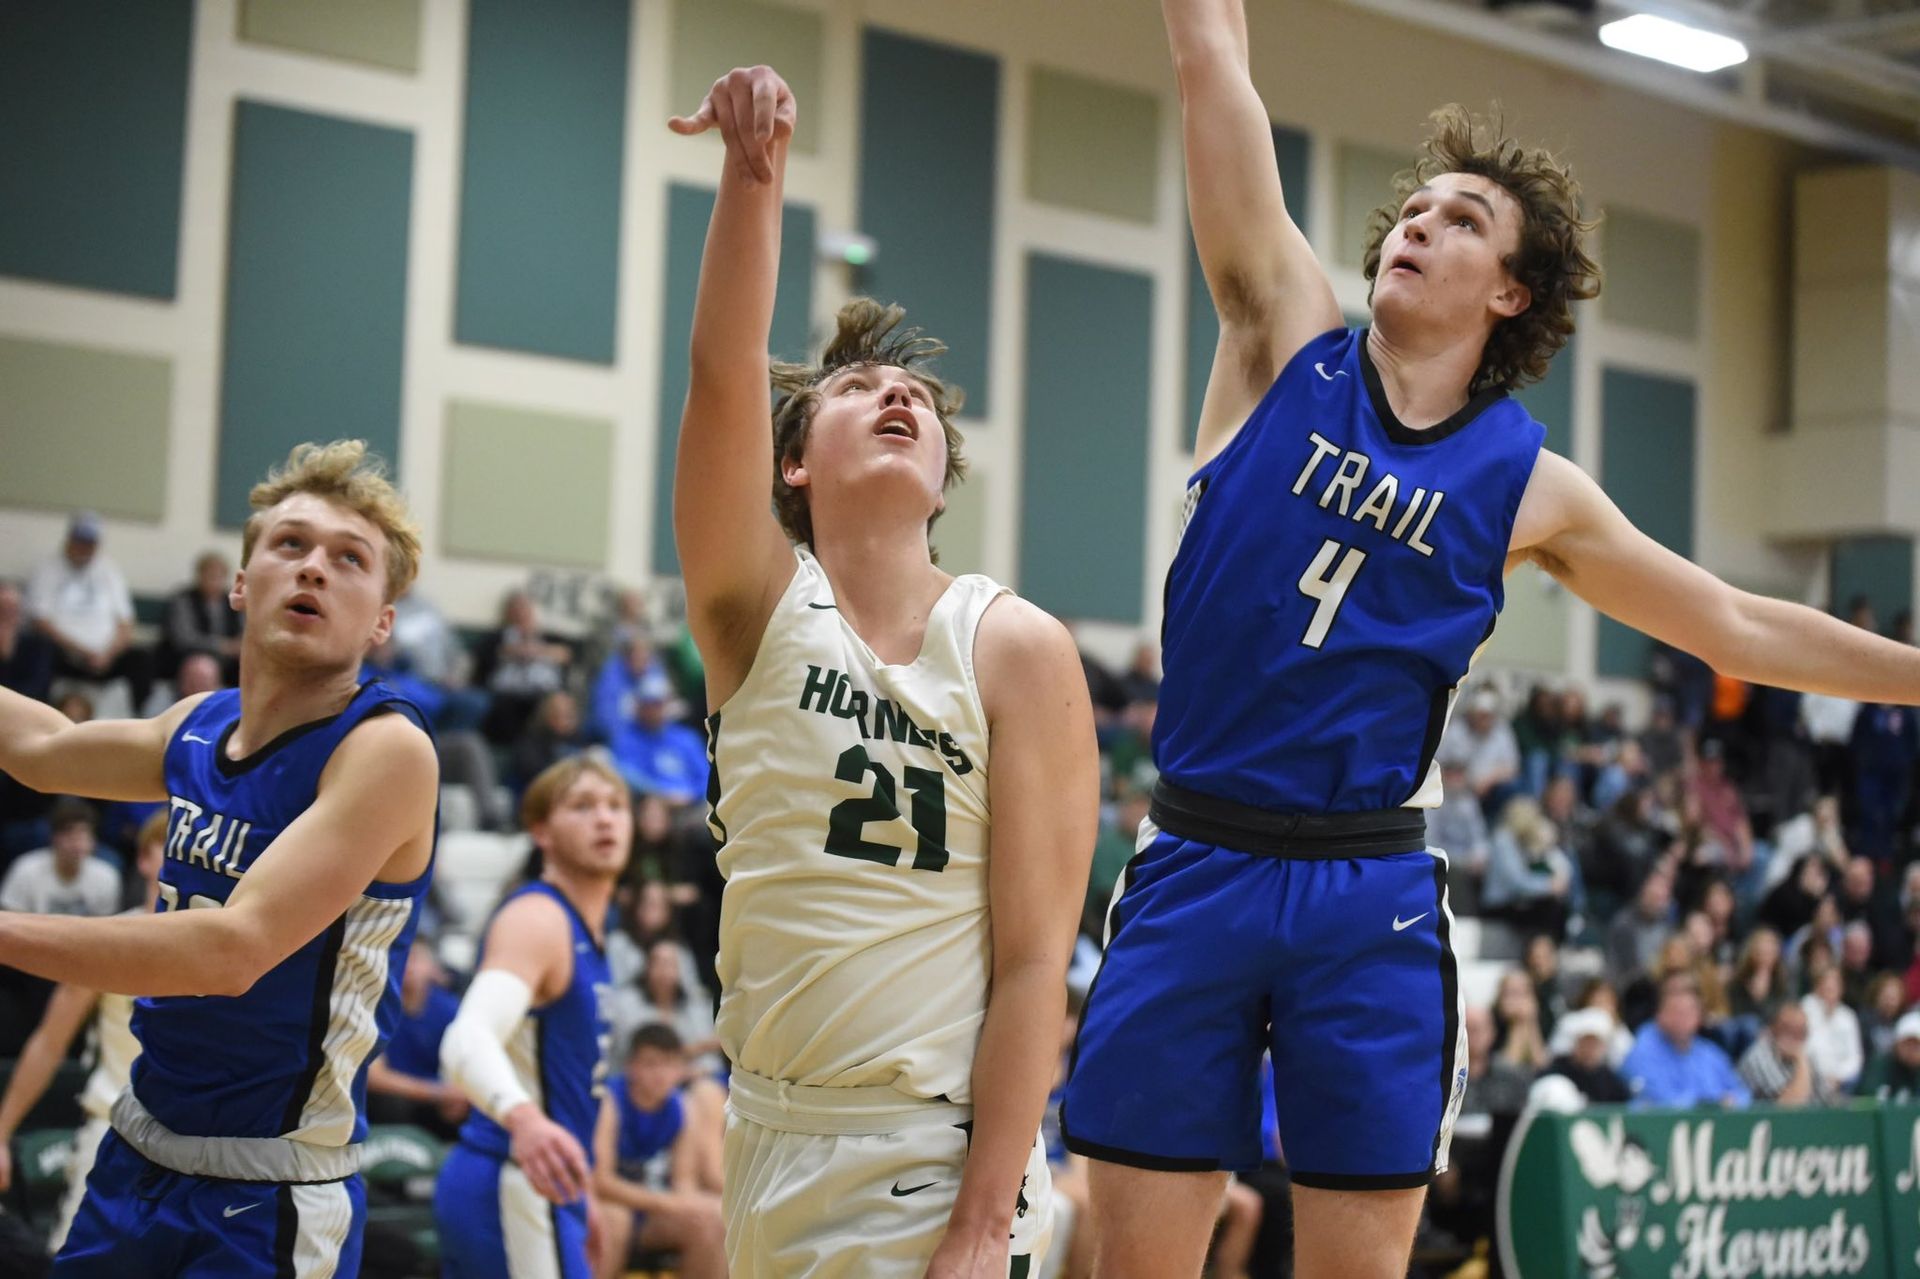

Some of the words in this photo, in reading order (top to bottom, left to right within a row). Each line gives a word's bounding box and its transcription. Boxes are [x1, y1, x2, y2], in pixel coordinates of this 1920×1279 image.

[1291, 431, 1445, 558] TRAIL
[1298, 539, 1367, 648] 4
[798, 664, 974, 776] HORNS
[166, 795, 252, 880] TRAIL
[823, 743, 950, 873] 21
[1651, 1119, 1874, 1204] Malvern
[1671, 1203, 1870, 1279] Hornets
